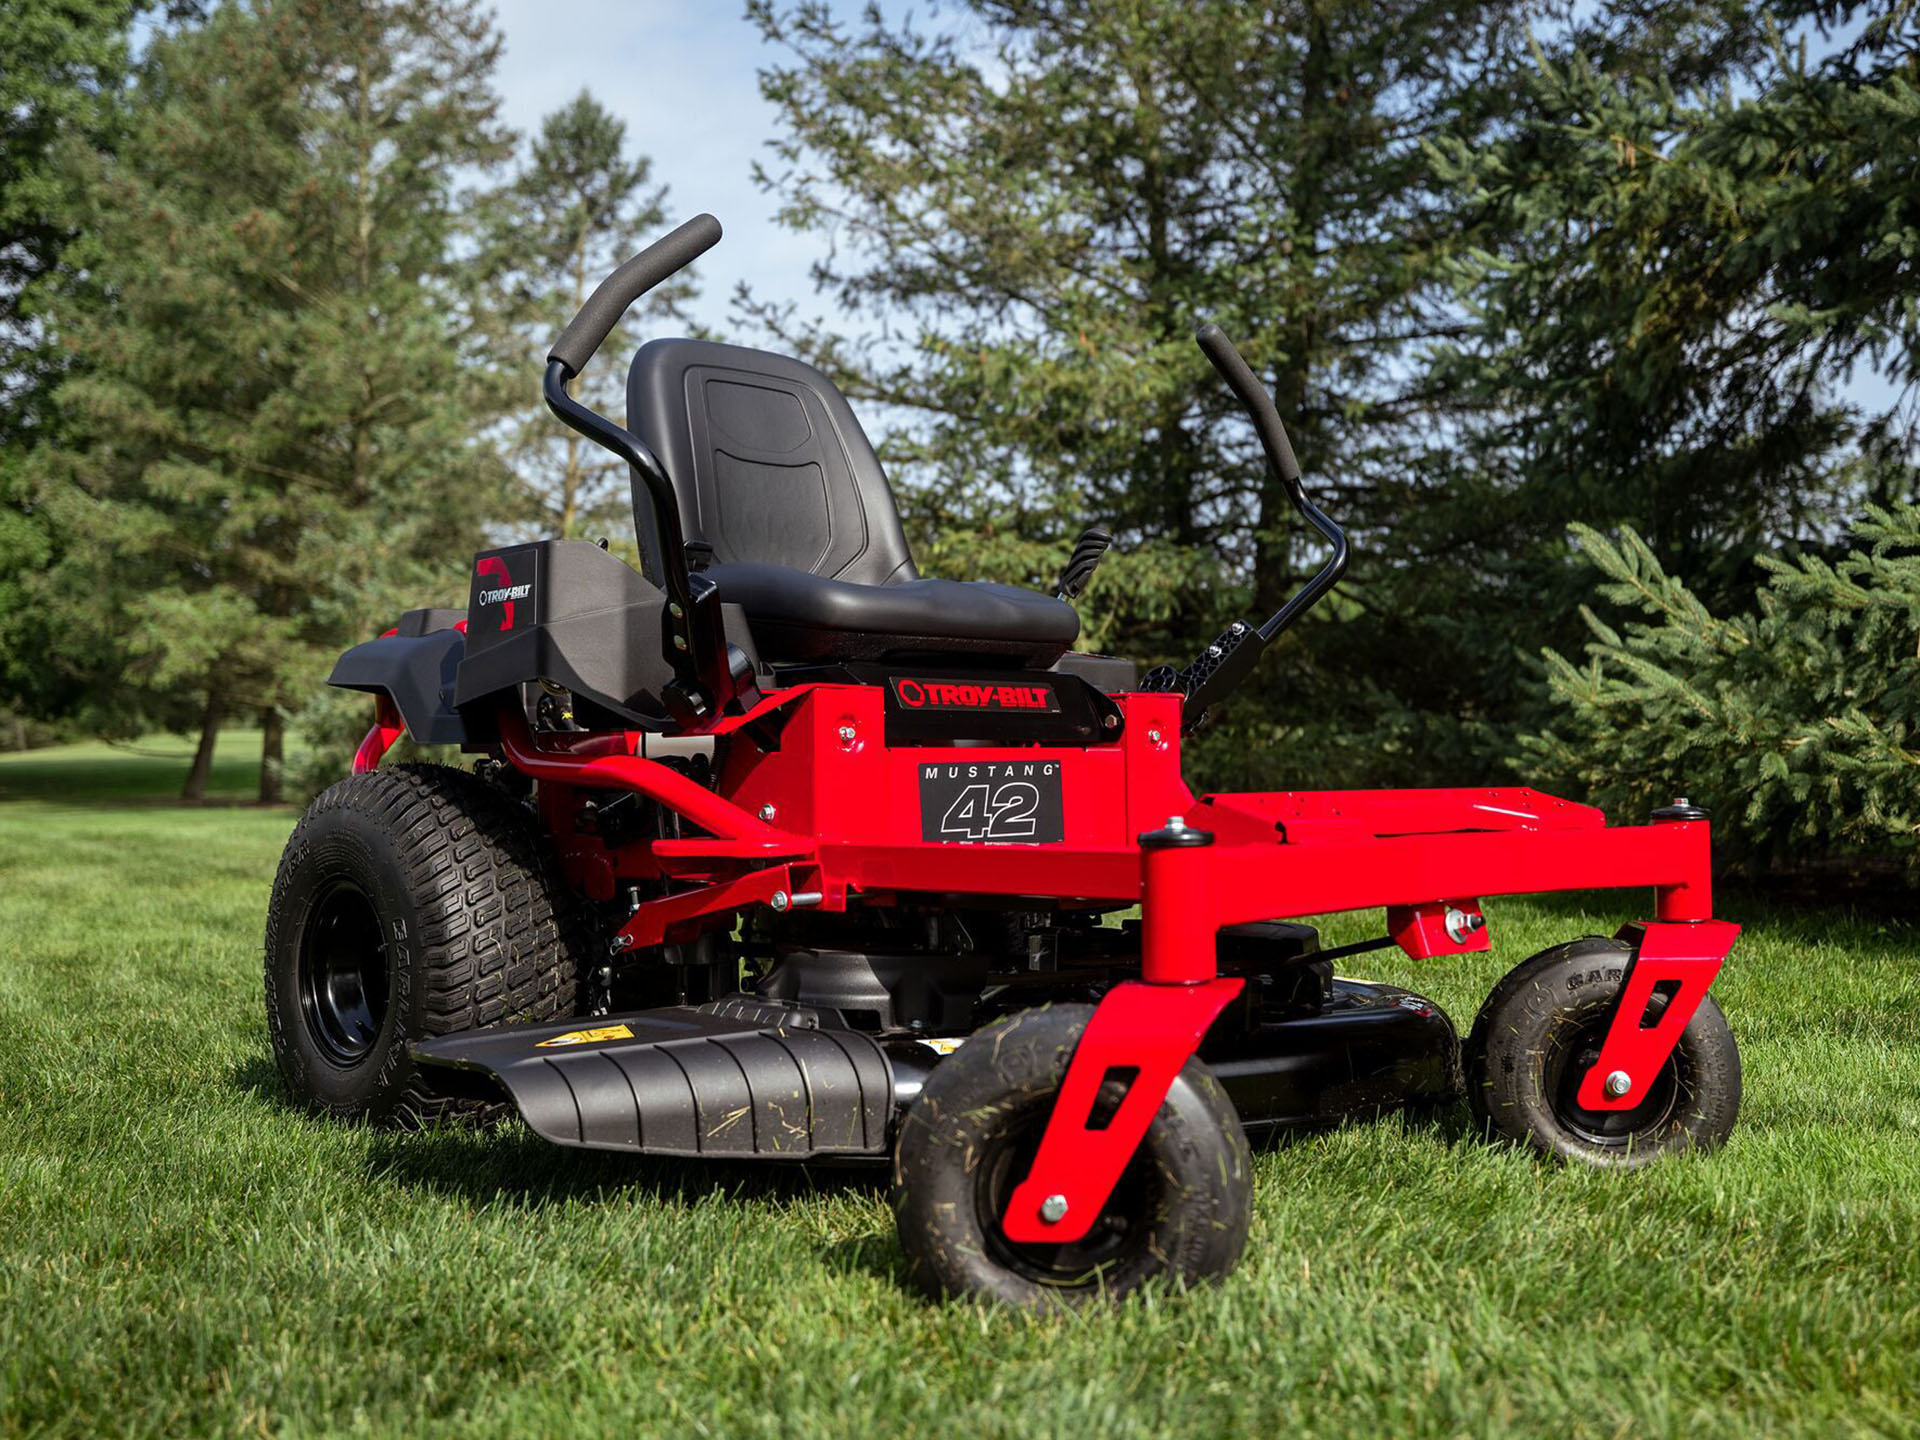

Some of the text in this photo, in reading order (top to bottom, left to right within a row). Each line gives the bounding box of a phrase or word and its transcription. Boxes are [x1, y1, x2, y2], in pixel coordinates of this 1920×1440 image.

[486, 584, 532, 603] TROY-BILT
[921, 684, 1050, 709] TROY-BILT
[925, 764, 1054, 779] MUSTANG
[940, 782, 1040, 839] 42
